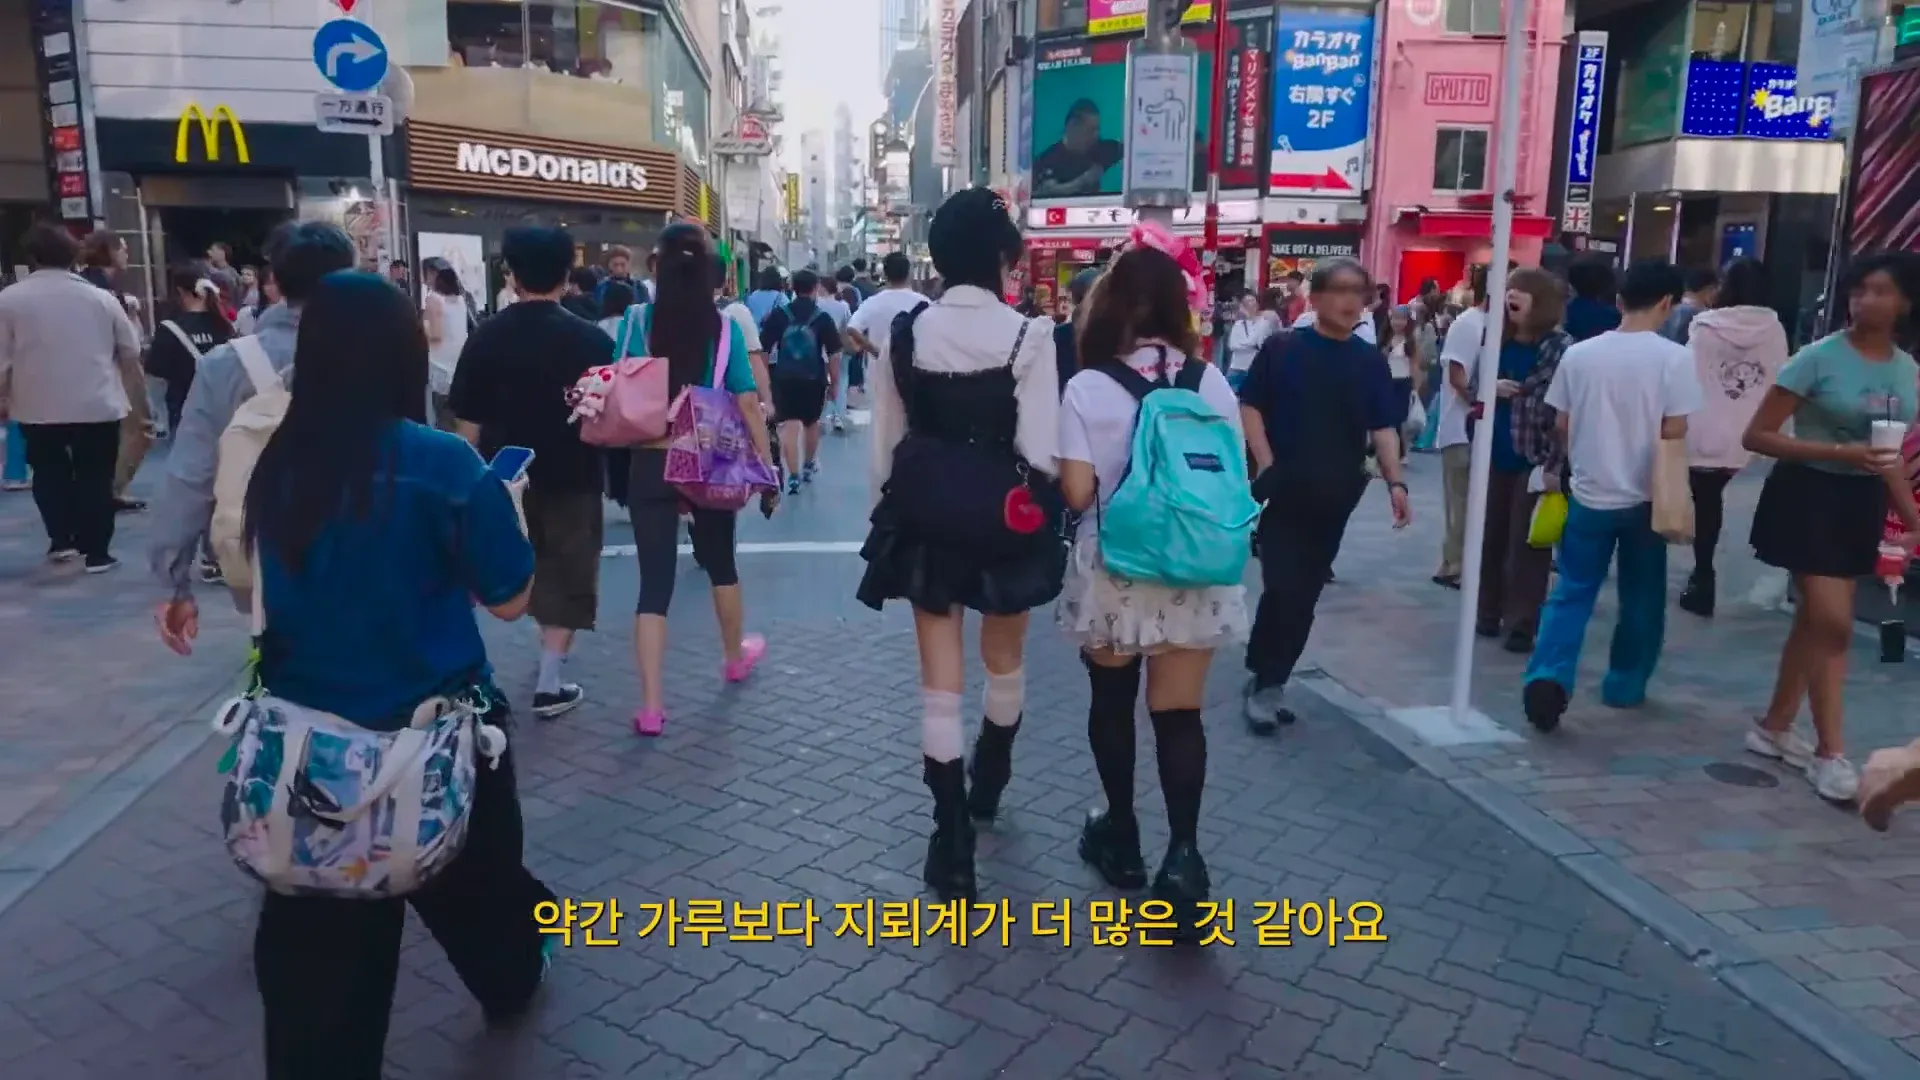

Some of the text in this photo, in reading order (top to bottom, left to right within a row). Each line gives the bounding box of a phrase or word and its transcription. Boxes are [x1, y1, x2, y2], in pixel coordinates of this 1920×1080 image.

[1293, 30, 1361, 51] カラオケ
[1292, 53, 1360, 71] BanBan
[1585, 48, 1600, 58] 2F
[1429, 78, 1486, 102] GYUTTO
[1578, 64, 1598, 124] カラオケ
[1307, 109, 1335, 128] 2F
[456, 142, 648, 191] McDonald's
[1271, 244, 1291, 255] TAKE
[1292, 244, 1308, 255] OUT
[1316, 245, 1353, 256] DELIVERY
